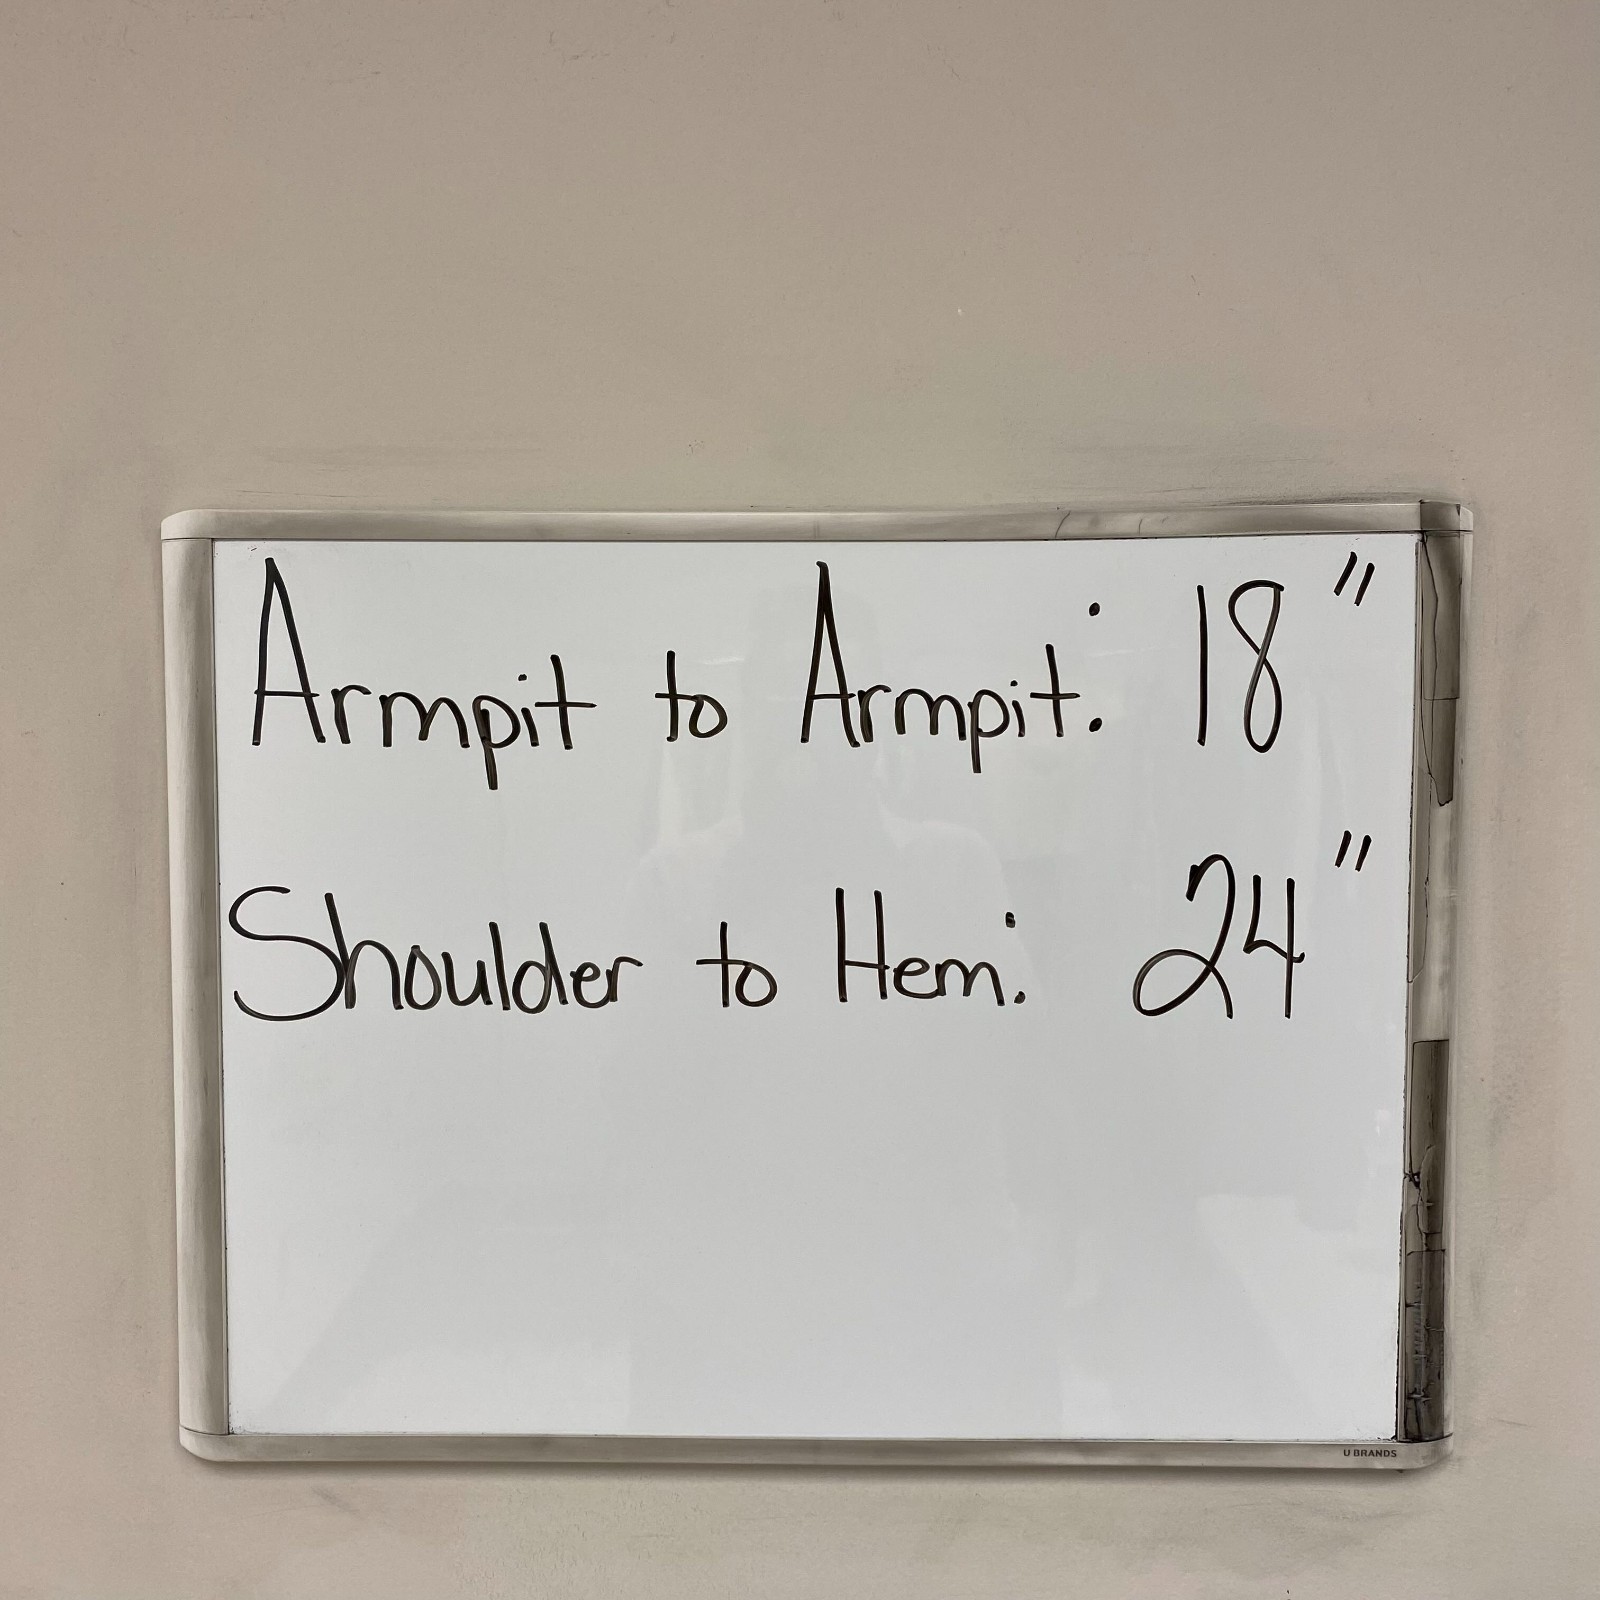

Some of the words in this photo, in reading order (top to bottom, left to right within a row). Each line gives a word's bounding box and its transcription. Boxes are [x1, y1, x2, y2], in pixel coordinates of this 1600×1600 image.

[252, 558, 597, 791] Armpit
[655, 651, 728, 743] to
[801, 561, 1103, 774] Armpit:
[229, 886, 643, 1021] Shoulder
[696, 922, 777, 1009] to
[836, 888, 1026, 1007] Hem:
[1343, 1449, 1351, 1457] U
[1353, 1449, 1397, 1458] BRANDS
